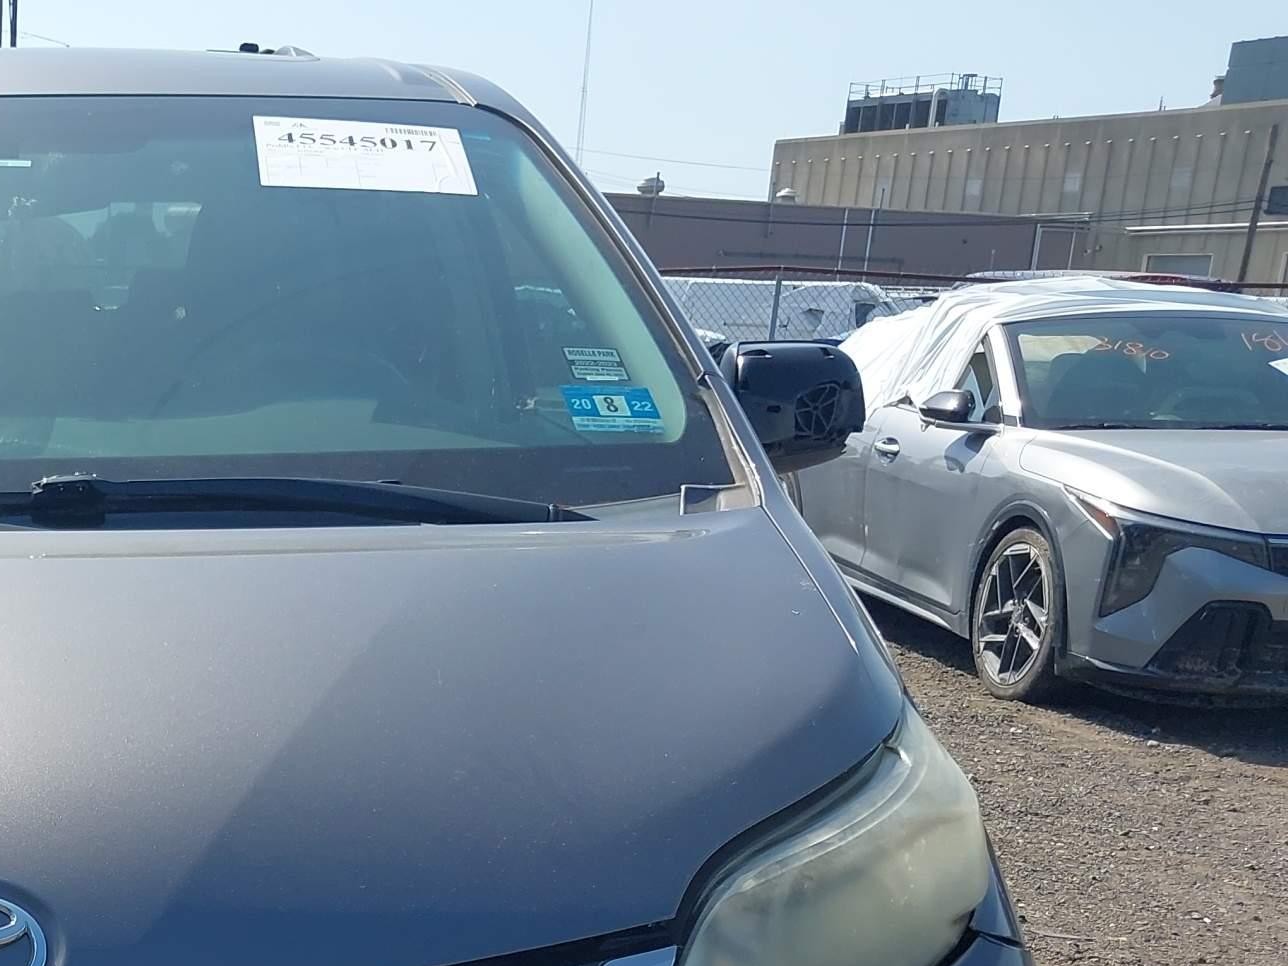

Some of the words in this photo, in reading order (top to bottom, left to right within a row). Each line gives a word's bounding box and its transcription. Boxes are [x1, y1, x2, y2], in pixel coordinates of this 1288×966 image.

[277, 132, 437, 152] 45545017
[571, 398, 592, 410] 20
[603, 396, 619, 413] 8
[631, 400, 654, 412] 22
